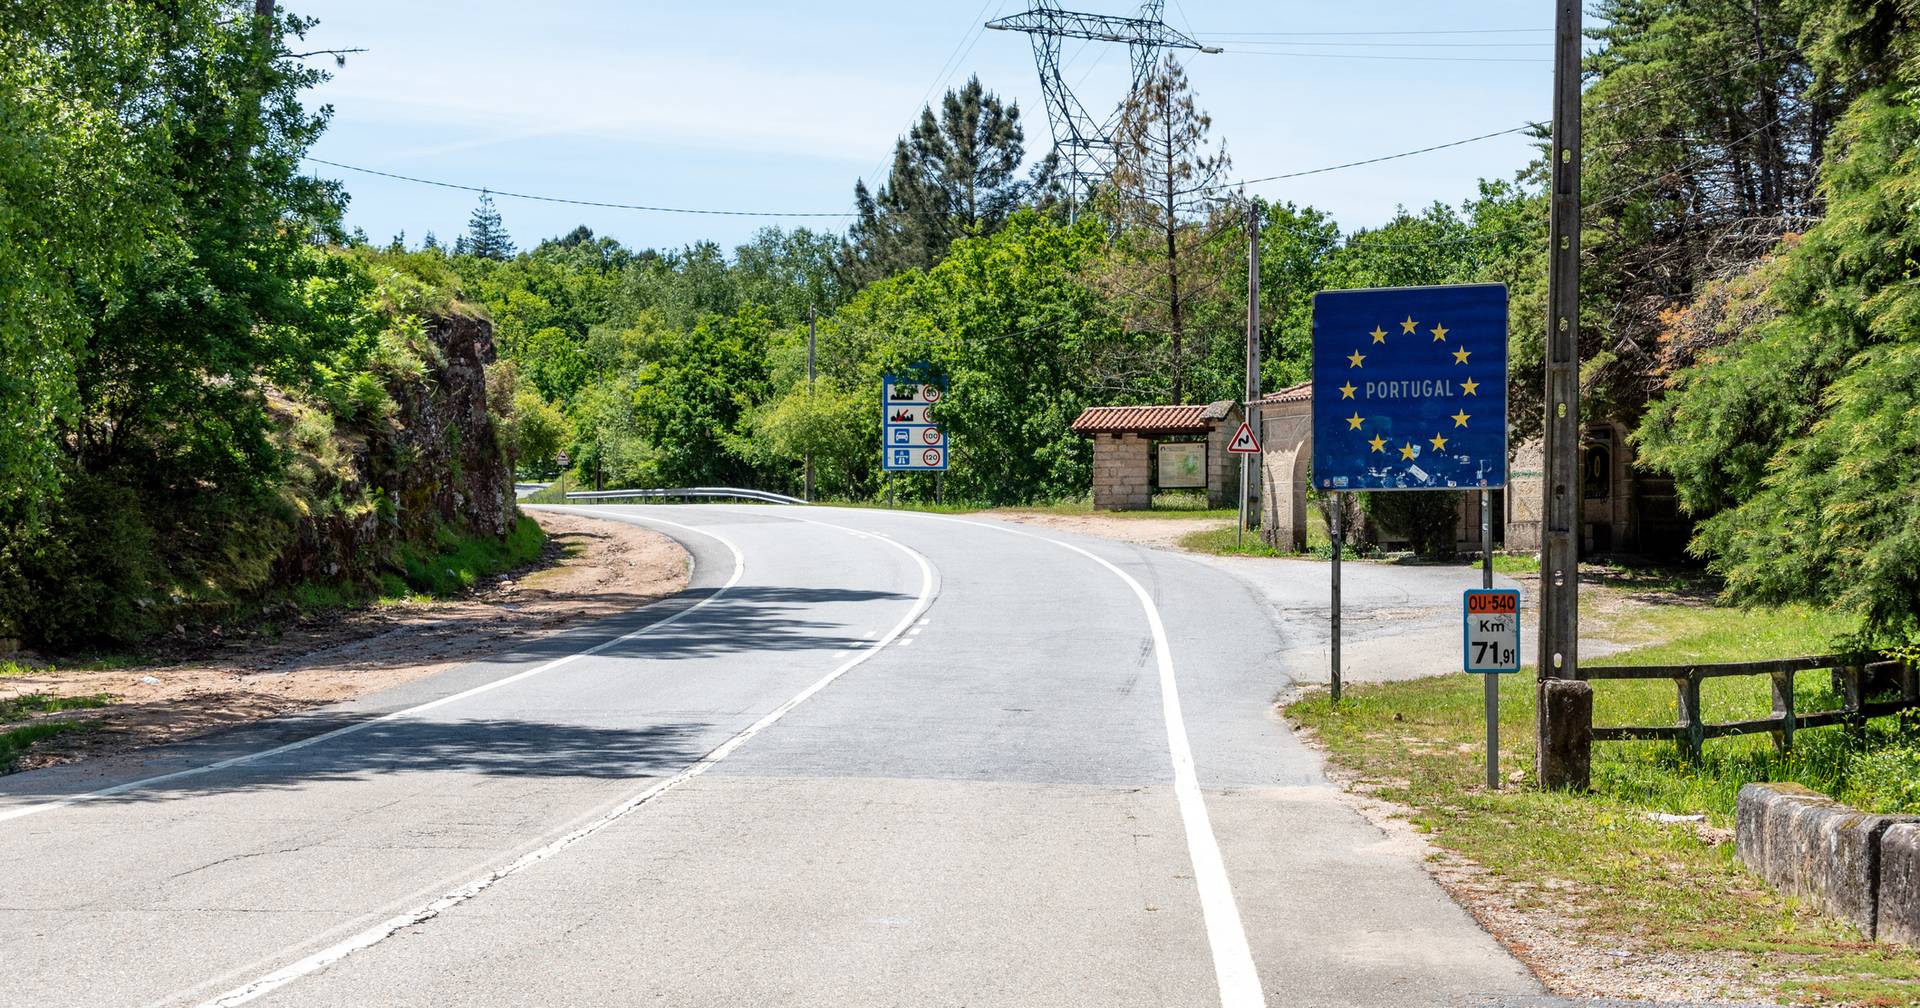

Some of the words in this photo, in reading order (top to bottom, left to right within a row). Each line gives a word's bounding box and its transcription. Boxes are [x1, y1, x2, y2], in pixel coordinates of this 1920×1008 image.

[1366, 380, 1454, 399] PORTUGAL
[1469, 595, 1515, 610] OU-540
[1480, 620, 1505, 632] Km
[1472, 641, 1515, 667] 71,91
